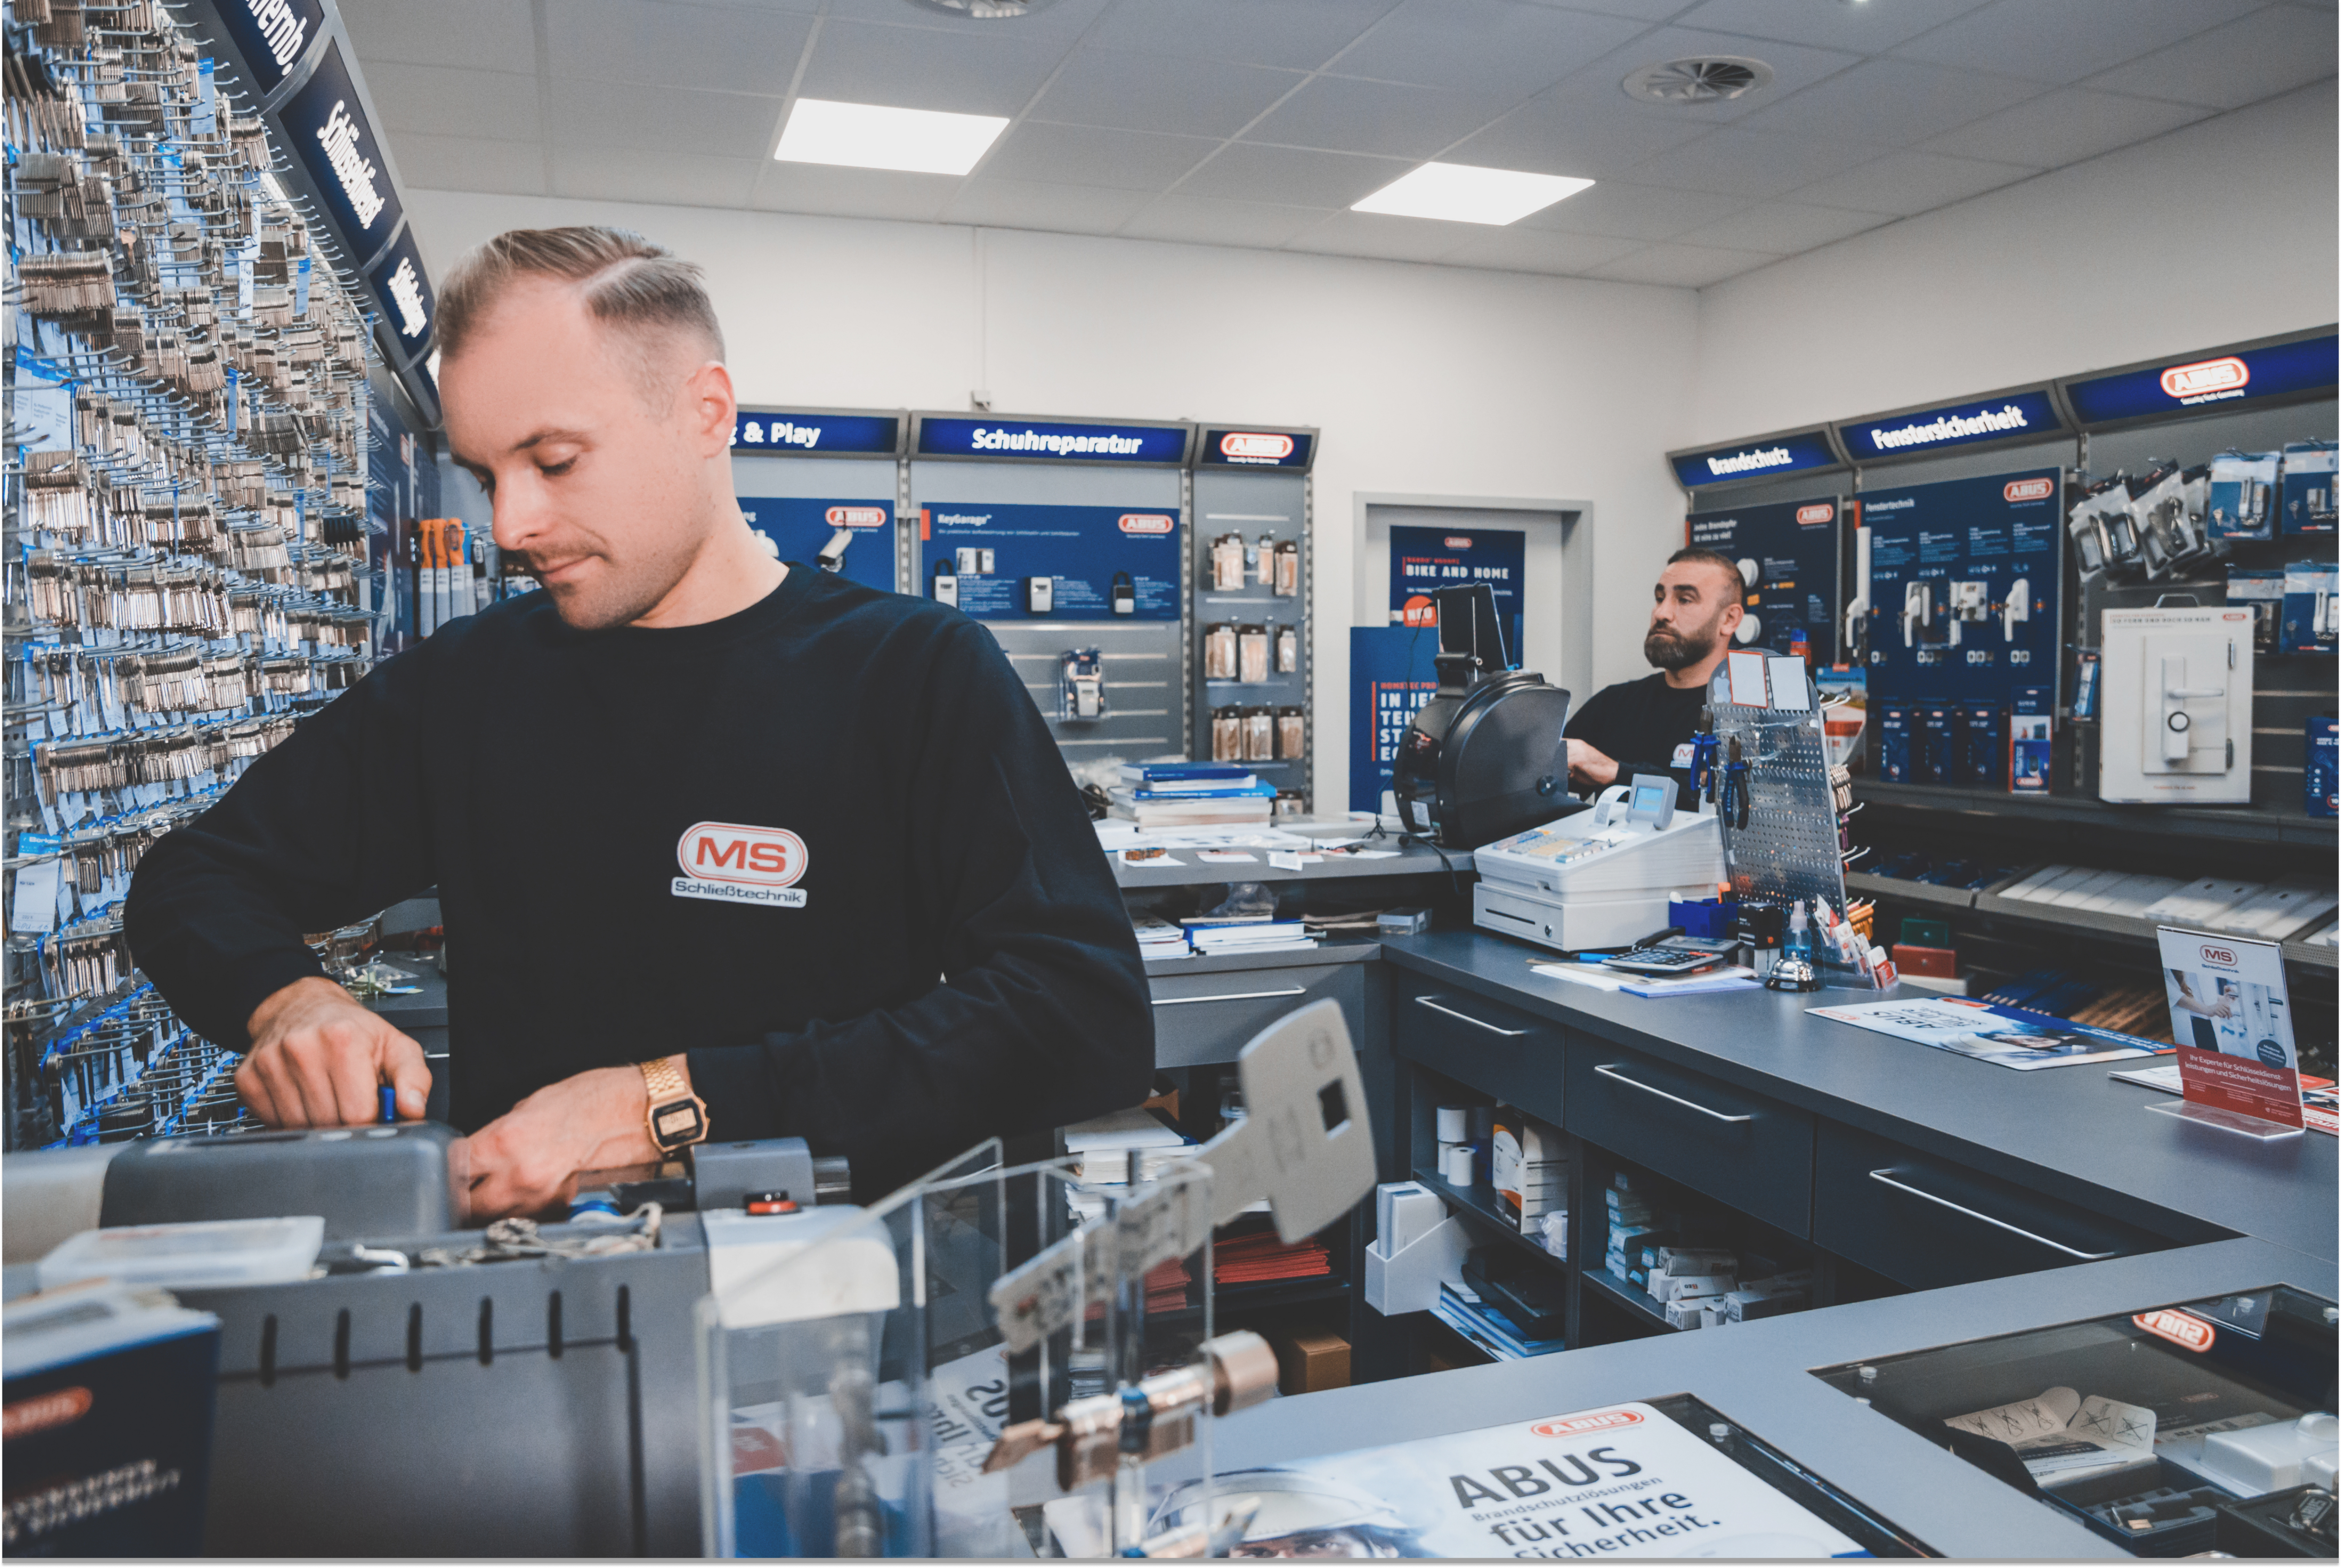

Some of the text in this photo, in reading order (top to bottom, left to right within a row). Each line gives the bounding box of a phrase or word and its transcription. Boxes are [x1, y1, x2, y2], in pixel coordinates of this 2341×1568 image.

[316, 99, 385, 229] Schlüsseldienst
[2174, 364, 2239, 391] ABUS
[743, 421, 764, 443] &
[770, 422, 821, 448] Play
[1871, 405, 2028, 450] Fenstersicherheit
[972, 428, 1143, 456] Schuhreparatur
[1229, 438, 1284, 453] ABUS
[1707, 447, 1793, 475] Brandschutz
[2010, 483, 2046, 498] ABUS
[1801, 509, 1828, 521] ABUS
[1865, 499, 1915, 513] Fenstertechnik
[1127, 518, 1166, 529] ABUS
[1407, 564, 1509, 580] BIKE AND HOME
[1380, 692, 1401, 708] IN
[696, 837, 787, 873] MS
[675, 880, 802, 903] Schließtechnik
[2204, 949, 2232, 962] MS
[2201, 963, 2239, 974] Schließtechnik
[2185, 1061, 2216, 1074] leistungen
[2228, 1071, 2292, 1092] Sicherheitslösungen
[2199, 1056, 2223, 1068] Experte
[2233, 1064, 2284, 1080] Schlüsseldienst-
[1552, 1412, 1631, 1435] ABUS
[1449, 1446, 1642, 1509] ABUS
[1471, 1476, 1663, 1522] Brandschutzlösungen
[1489, 1492, 1693, 1546] für Ihre
